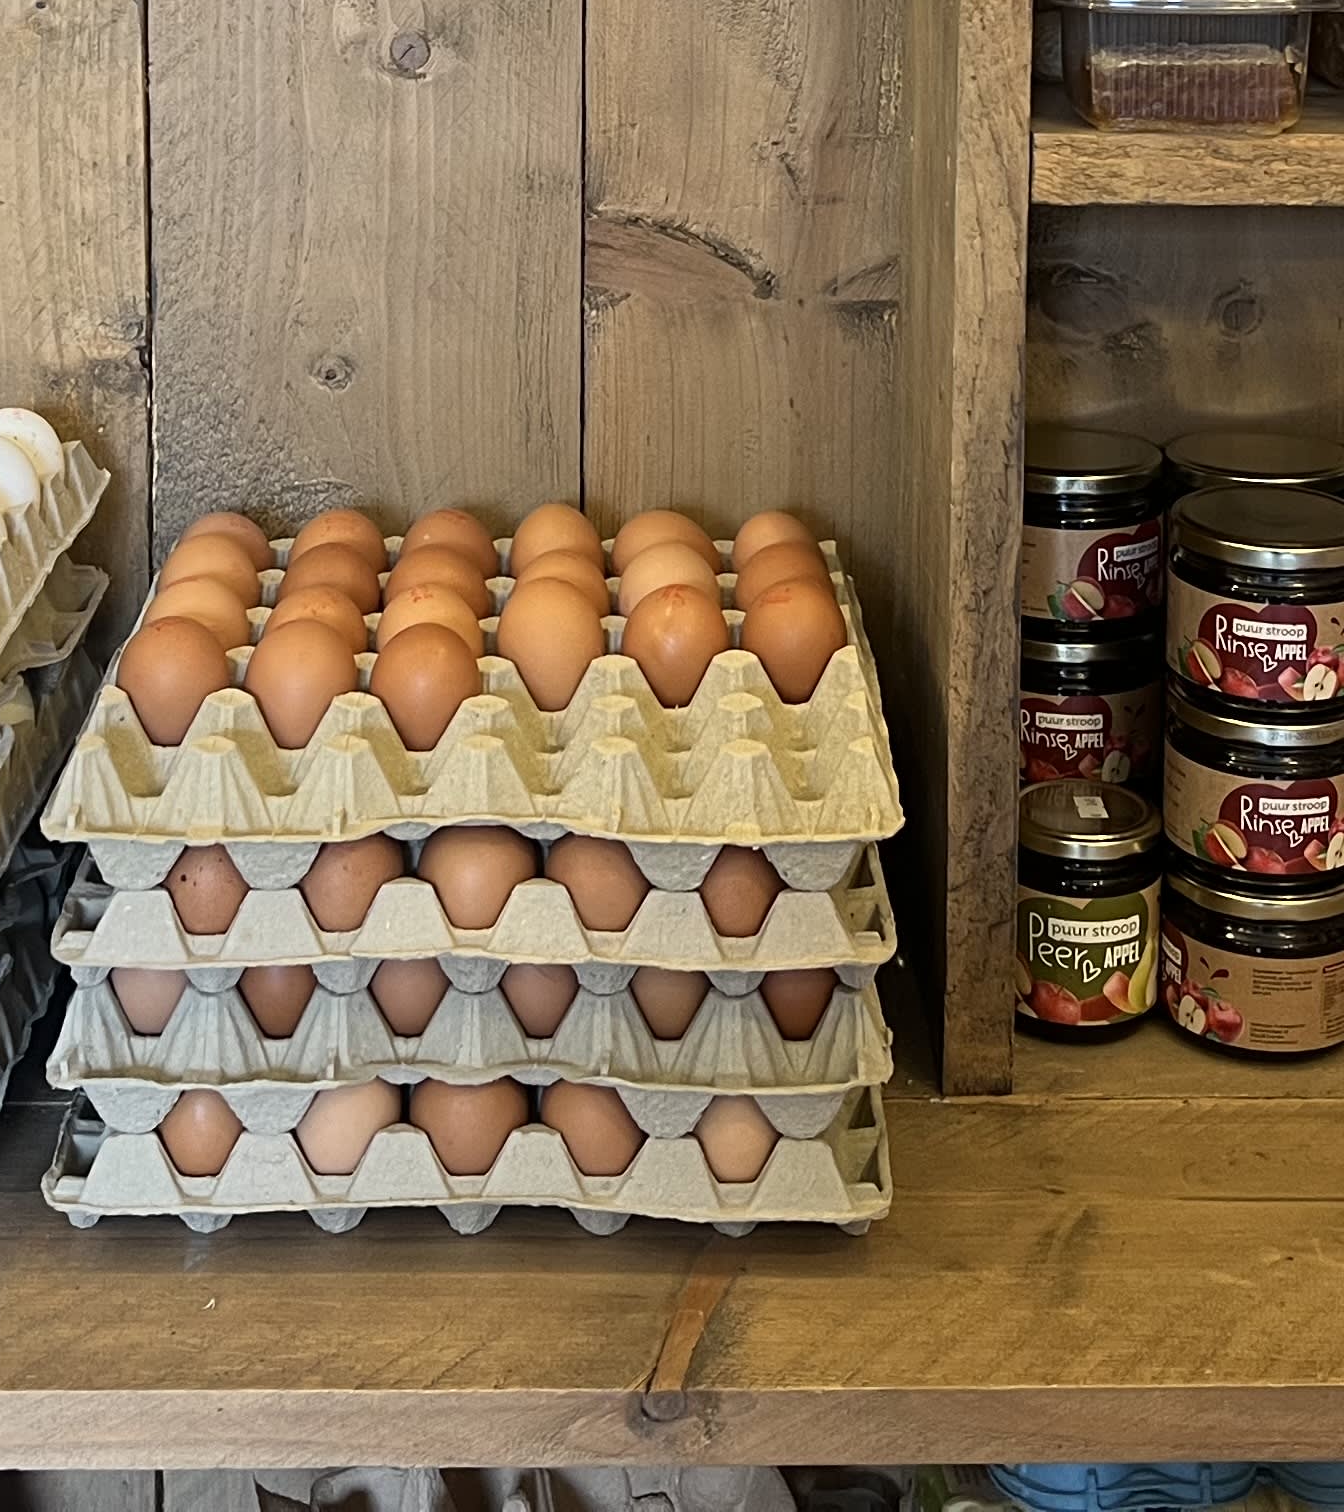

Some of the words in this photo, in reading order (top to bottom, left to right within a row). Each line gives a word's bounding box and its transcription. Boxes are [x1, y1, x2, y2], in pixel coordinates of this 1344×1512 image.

[1097, 548, 1141, 581] Rinse
[1216, 614, 1268, 660] Rinse
[1275, 644, 1307, 660] APPEL
[1236, 623, 1262, 634] puur
[1266, 627, 1304, 637] stroop
[1020, 709, 1069, 749] Rinse
[1075, 733, 1103, 748] APPEL
[1038, 715, 1064, 726] puur
[1066, 716, 1101, 727] stroop
[1240, 795, 1294, 836] Rinse
[1301, 815, 1329, 834] APPEL
[1262, 801, 1290, 811] puur
[1292, 801, 1327, 810] stroop
[1029, 912, 1088, 970] Peer
[1104, 940, 1140, 968] APPEL
[1052, 923, 1088, 936] puur
[1092, 921, 1137, 937] stroop
